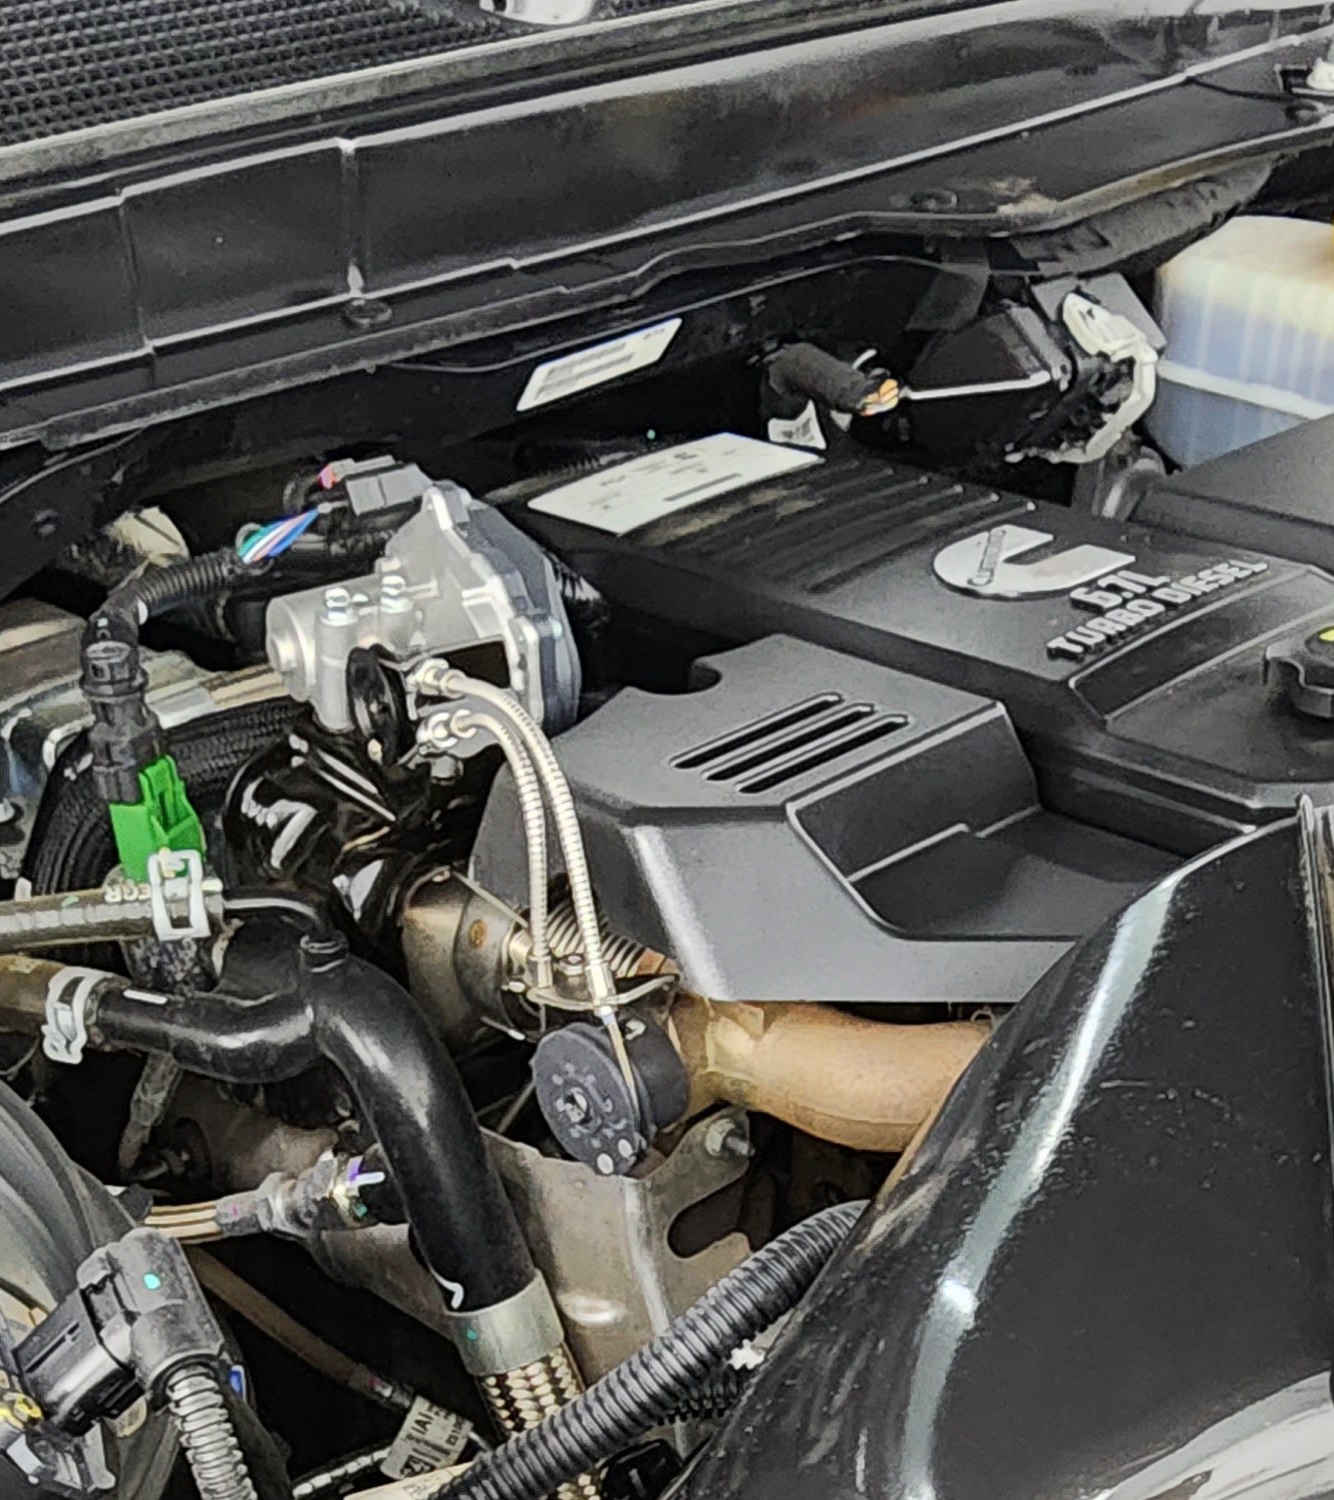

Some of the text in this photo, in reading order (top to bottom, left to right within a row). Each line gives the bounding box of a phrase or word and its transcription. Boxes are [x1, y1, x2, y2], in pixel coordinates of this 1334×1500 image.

[1046, 559, 1267, 655] TURBO DIESEL
[1069, 570, 1171, 610] 6.7L
